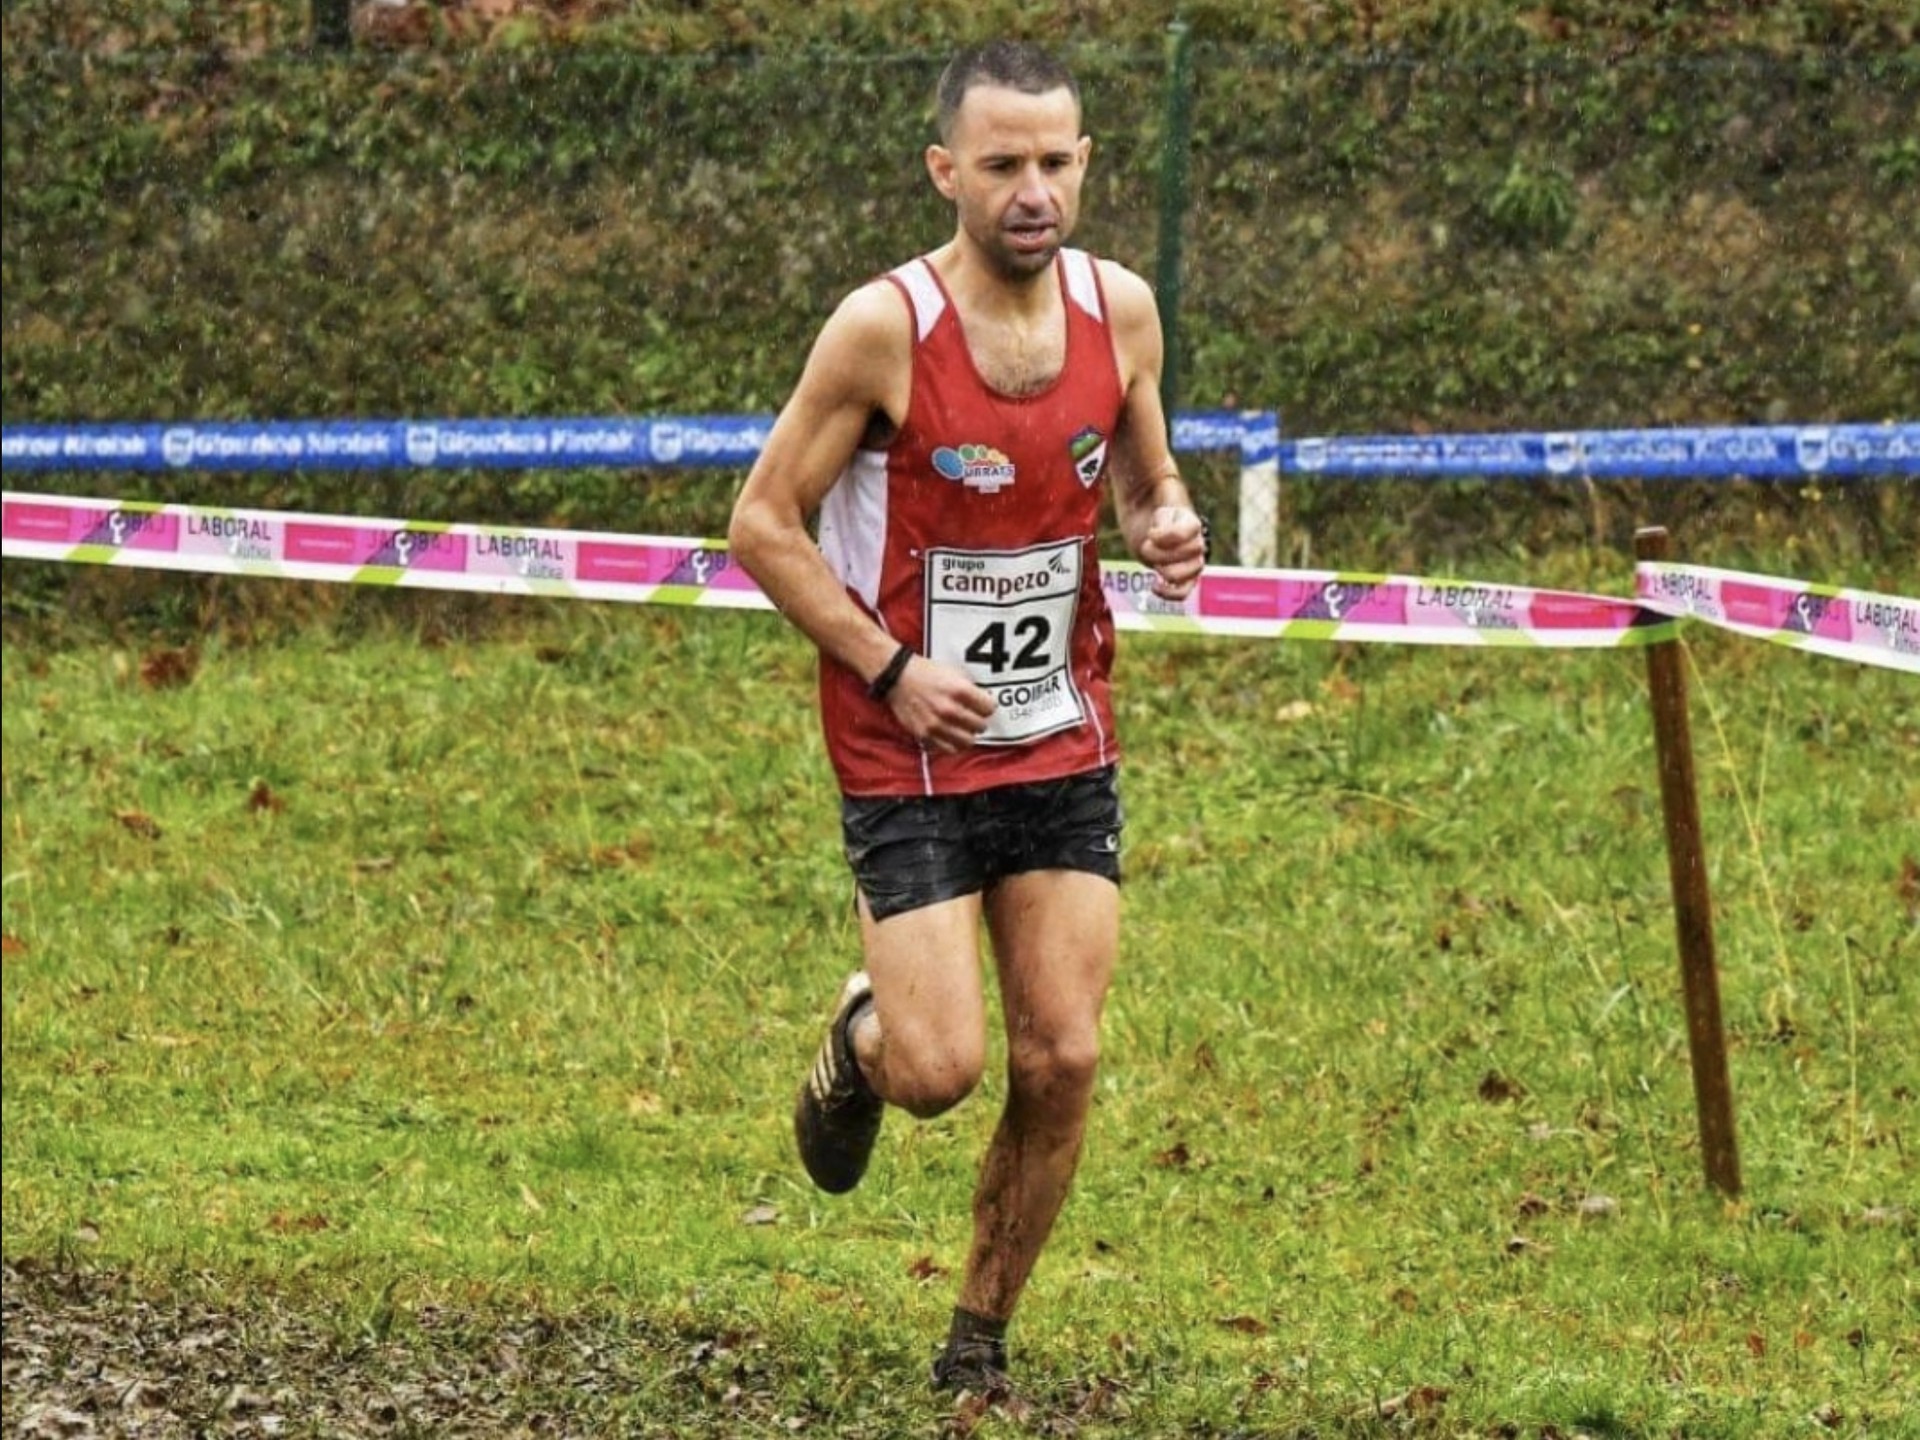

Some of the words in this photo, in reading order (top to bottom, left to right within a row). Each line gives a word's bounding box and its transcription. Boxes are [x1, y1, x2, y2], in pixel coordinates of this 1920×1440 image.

[187, 515, 272, 541] LABORAL
[475, 534, 564, 561] LABORAL
[941, 557, 985, 572] grupo
[941, 571, 1050, 601] campezo
[1416, 584, 1514, 610] LABORAL
[1653, 572, 1712, 600] LABORAL
[1856, 601, 1918, 634] LABORAL
[964, 614, 1052, 674] 42
